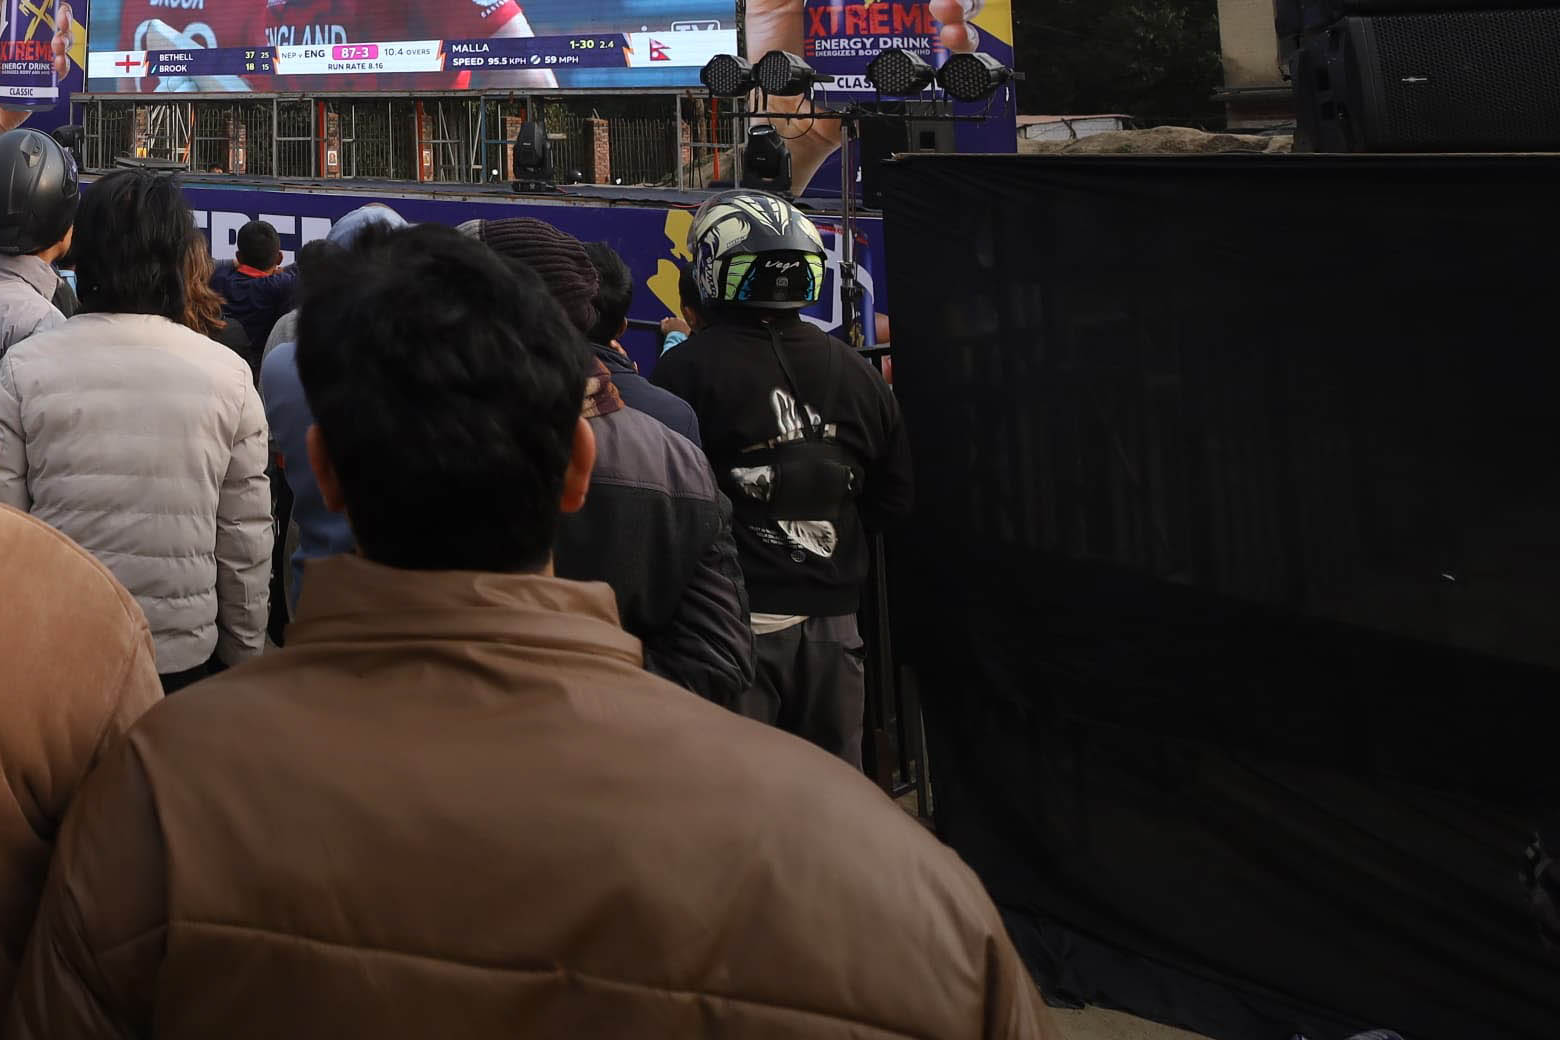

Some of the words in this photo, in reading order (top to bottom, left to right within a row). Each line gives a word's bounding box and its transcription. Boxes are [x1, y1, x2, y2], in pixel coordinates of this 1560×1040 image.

[452, 44, 489, 53] MALLA
[569, 40, 594, 49] 1-30
[599, 40, 614, 49] 2.4
[815, 37, 875, 50] ENERGY
[879, 37, 930, 49] DRINK
[0, 40, 55, 61] XTREM
[304, 49, 325, 58] ENG
[341, 47, 369, 58] 87-3
[384, 48, 404, 56] 10.4
[406, 48, 431, 56] OVERS
[159, 53, 193, 61] BETHELL
[245, 51, 255, 59] 37
[453, 57, 484, 66] SPEED
[487, 57, 508, 65] 95.5
[509, 57, 526, 65] KPH
[544, 56, 557, 64] 59
[559, 55, 579, 64] MPH
[1, 62, 27, 70] ENERGY
[28, 62, 50, 70] DRINK
[159, 64, 187, 73] BROOK
[245, 63, 255, 71] 18
[368, 62, 383, 70] 8.16
[9, 87, 34, 96] CLASSIC
